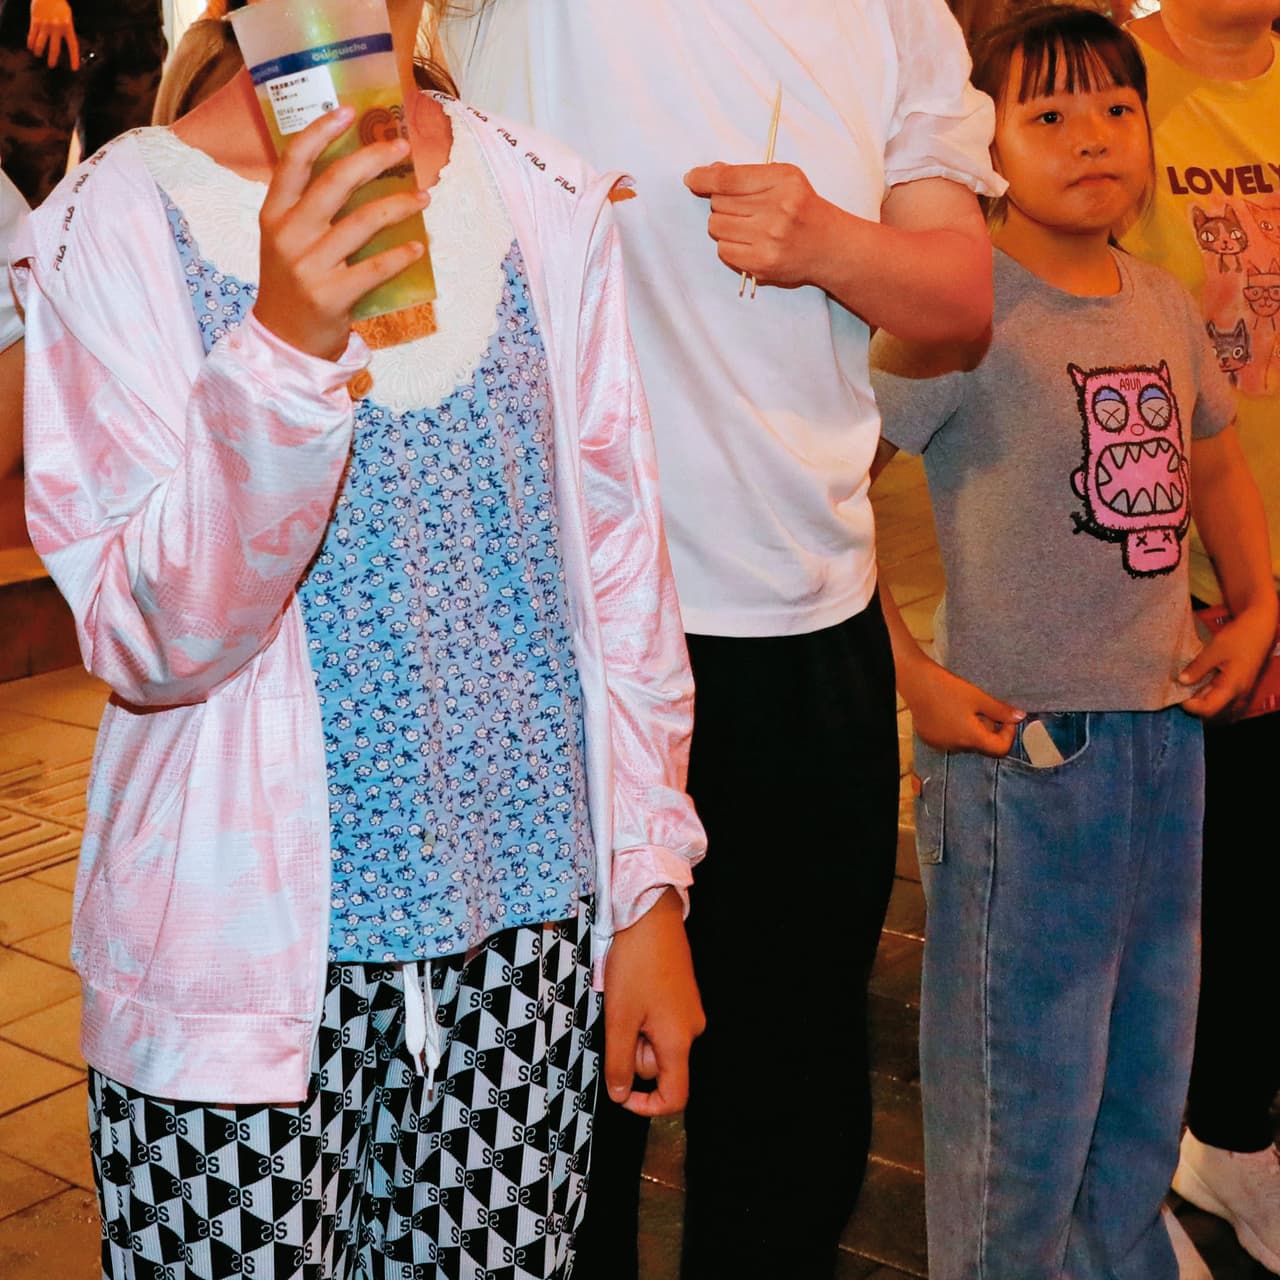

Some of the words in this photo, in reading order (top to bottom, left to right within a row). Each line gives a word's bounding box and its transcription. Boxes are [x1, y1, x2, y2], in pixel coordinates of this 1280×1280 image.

[524, 151, 547, 171] FILA
[72, 173, 89, 194] FILA
[554, 175, 577, 194] FILA
[62, 205, 75, 231] FILA
[52, 244, 67, 271] FILA
